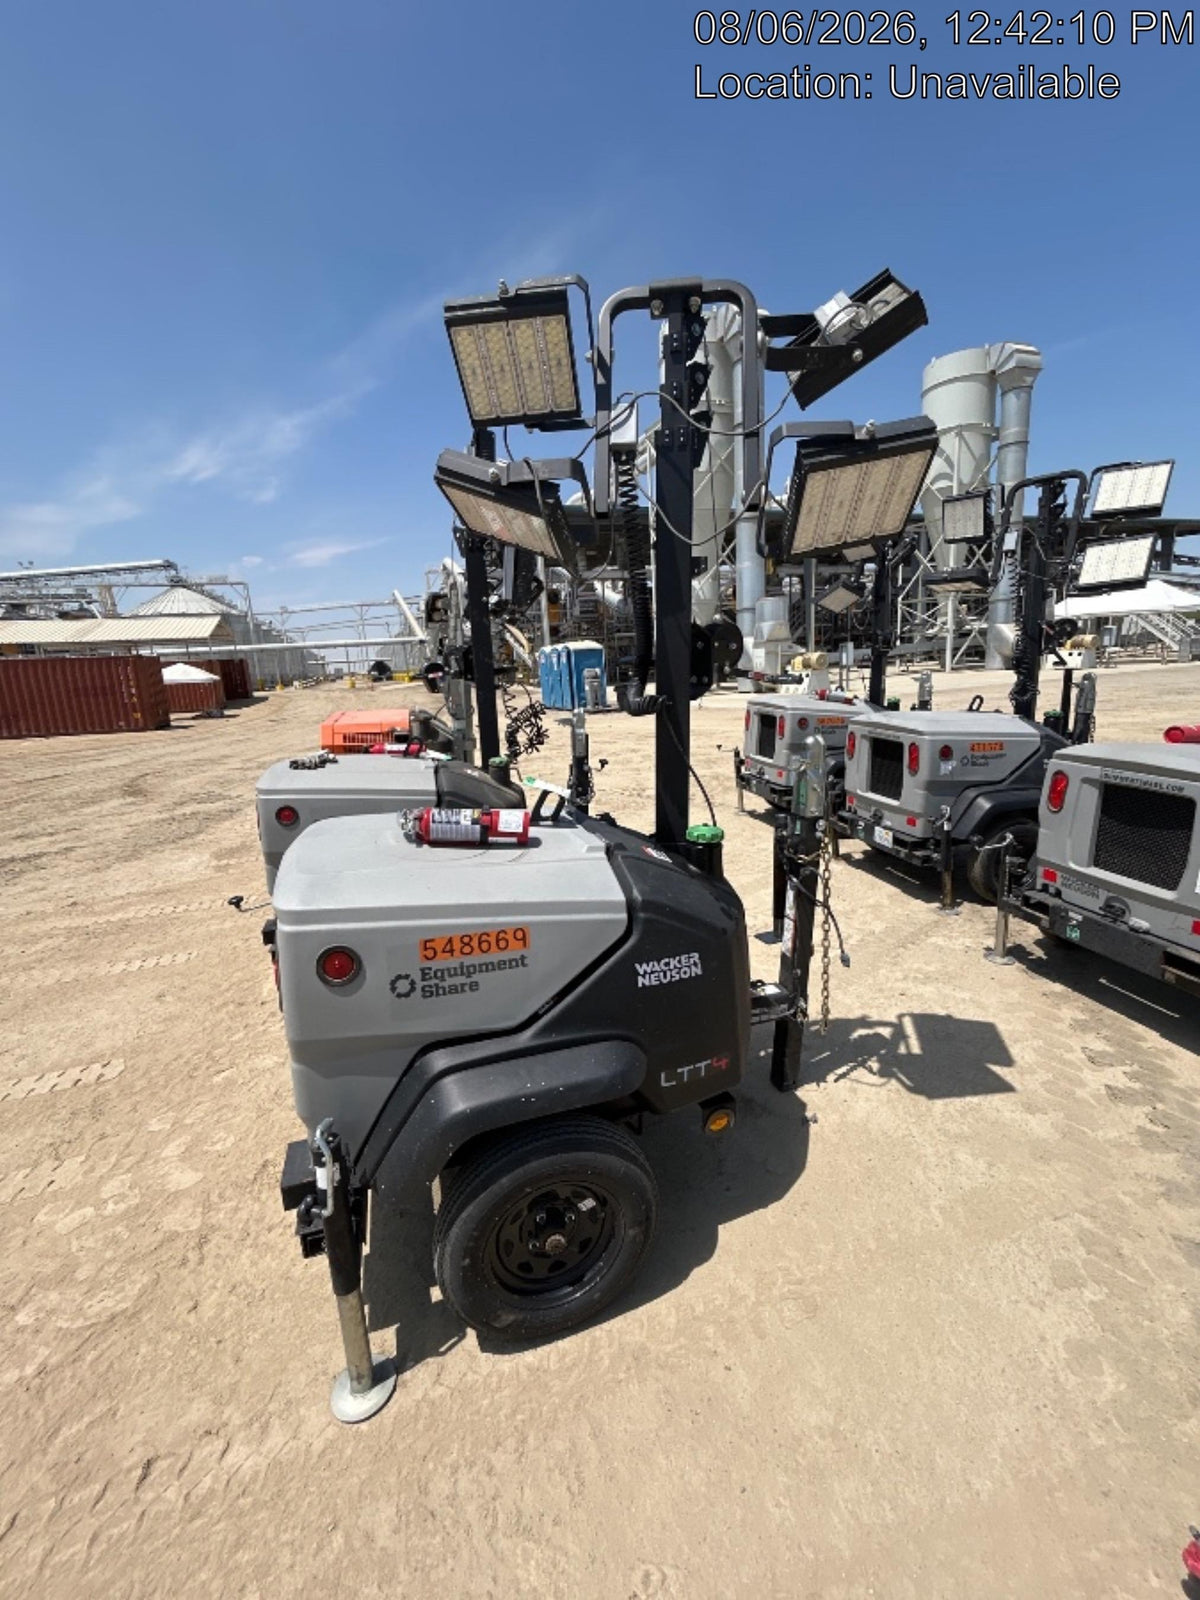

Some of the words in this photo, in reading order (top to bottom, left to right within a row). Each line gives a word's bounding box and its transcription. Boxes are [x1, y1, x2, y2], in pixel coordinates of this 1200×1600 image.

[422, 927, 527, 961] 548669
[419, 954, 529, 982] Equipment
[634, 952, 700, 975] WACKER
[637, 964, 703, 988] NEUSON
[420, 980, 480, 999] Share
[660, 1056, 730, 1087] LTT4
